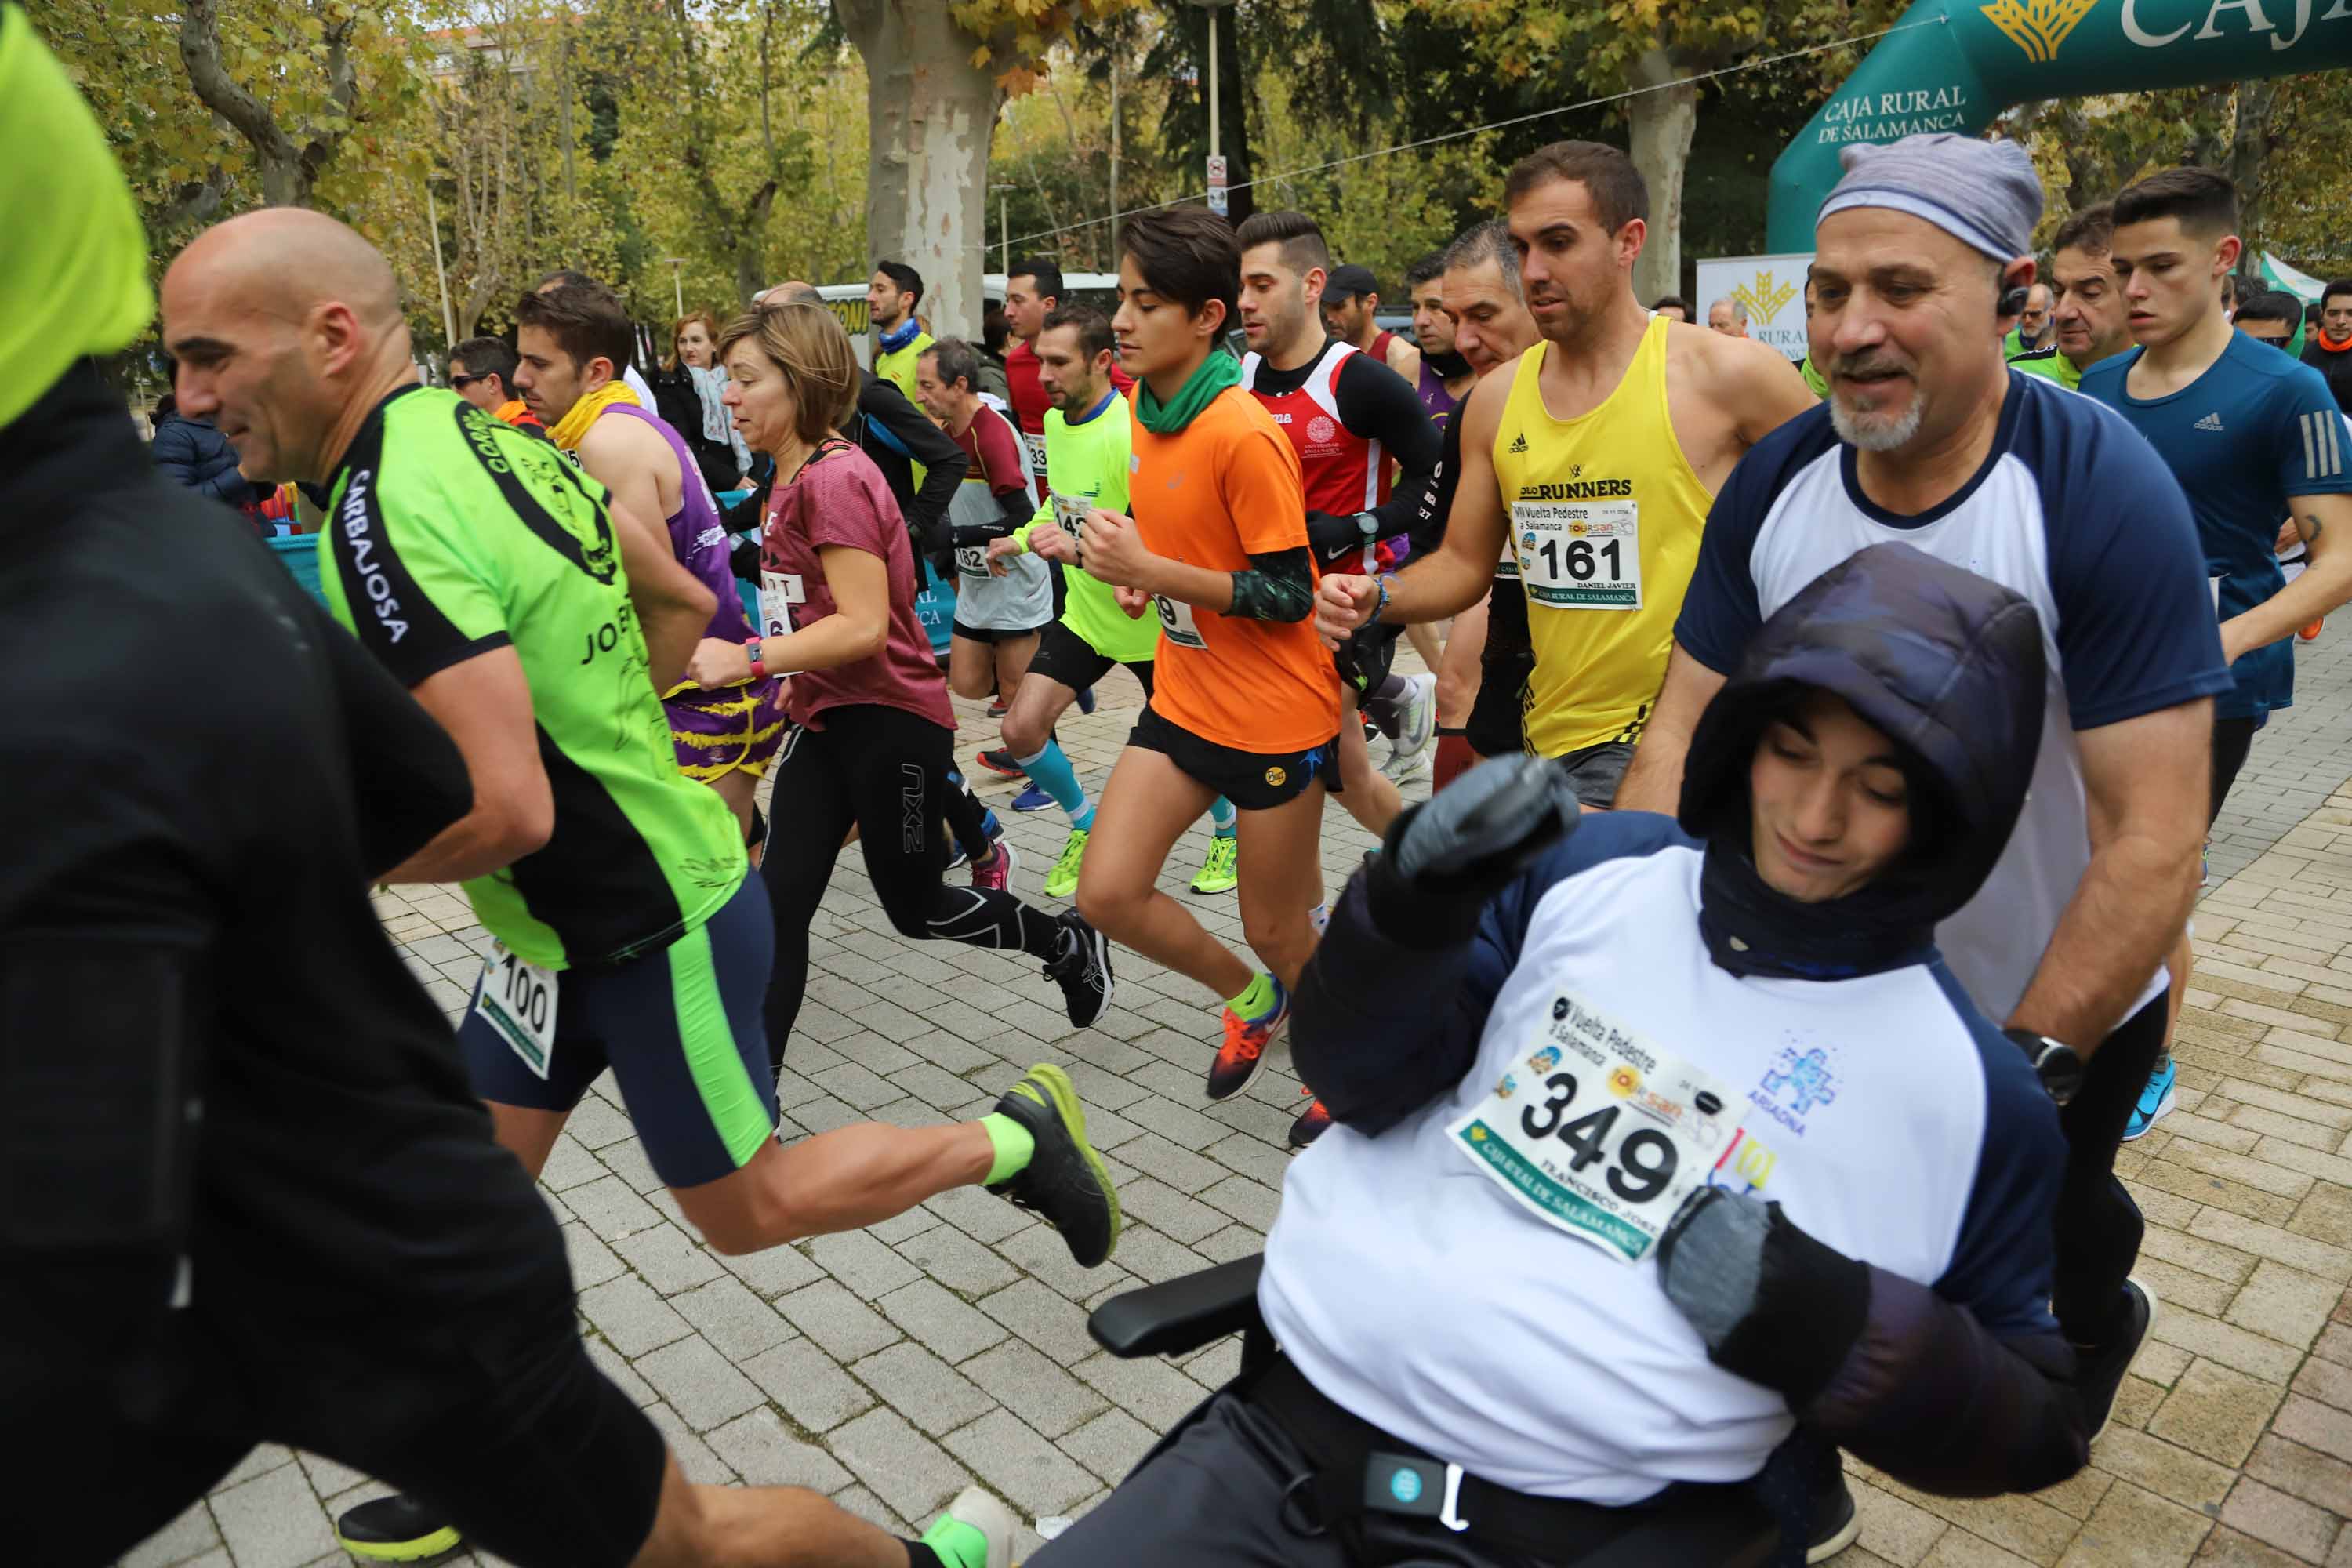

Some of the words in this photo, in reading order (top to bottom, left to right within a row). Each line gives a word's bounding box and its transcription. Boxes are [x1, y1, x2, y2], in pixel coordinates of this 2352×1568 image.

[2120, 0, 2352, 50] CAJ
[1824, 94, 1873, 124] CAJA
[1880, 85, 1966, 115] RURAL
[1818, 125, 1839, 143] DE
[1842, 112, 1965, 141] SALAMANCA
[1758, 329, 1808, 346] RURA
[1538, 479, 1632, 500] RUNNERS
[1526, 506, 1551, 518] Vuelta
[1553, 506, 1588, 519] Pedestre
[1526, 521, 1562, 531] Salamanca
[343, 470, 408, 643] CARBAJOSA
[957, 548, 984, 567] 182
[1540, 539, 1621, 581] 161
[1552, 592, 1574, 601] RURAL
[1588, 593, 1635, 602] SALAMANCA
[901, 764, 925, 853] 2XU
[500, 953, 546, 1034] 100
[1556, 1024, 1606, 1067] Salamanca
[1571, 1007, 1607, 1041] Vuelta
[1608, 1028, 1657, 1074] Pedestre
[1748, 1091, 1806, 1136] ARIADNA
[1521, 1073, 1679, 1203] 349
[1541, 1157, 1621, 1211] FRANCISCO
[1550, 1196, 1645, 1253] SALAMANCA
